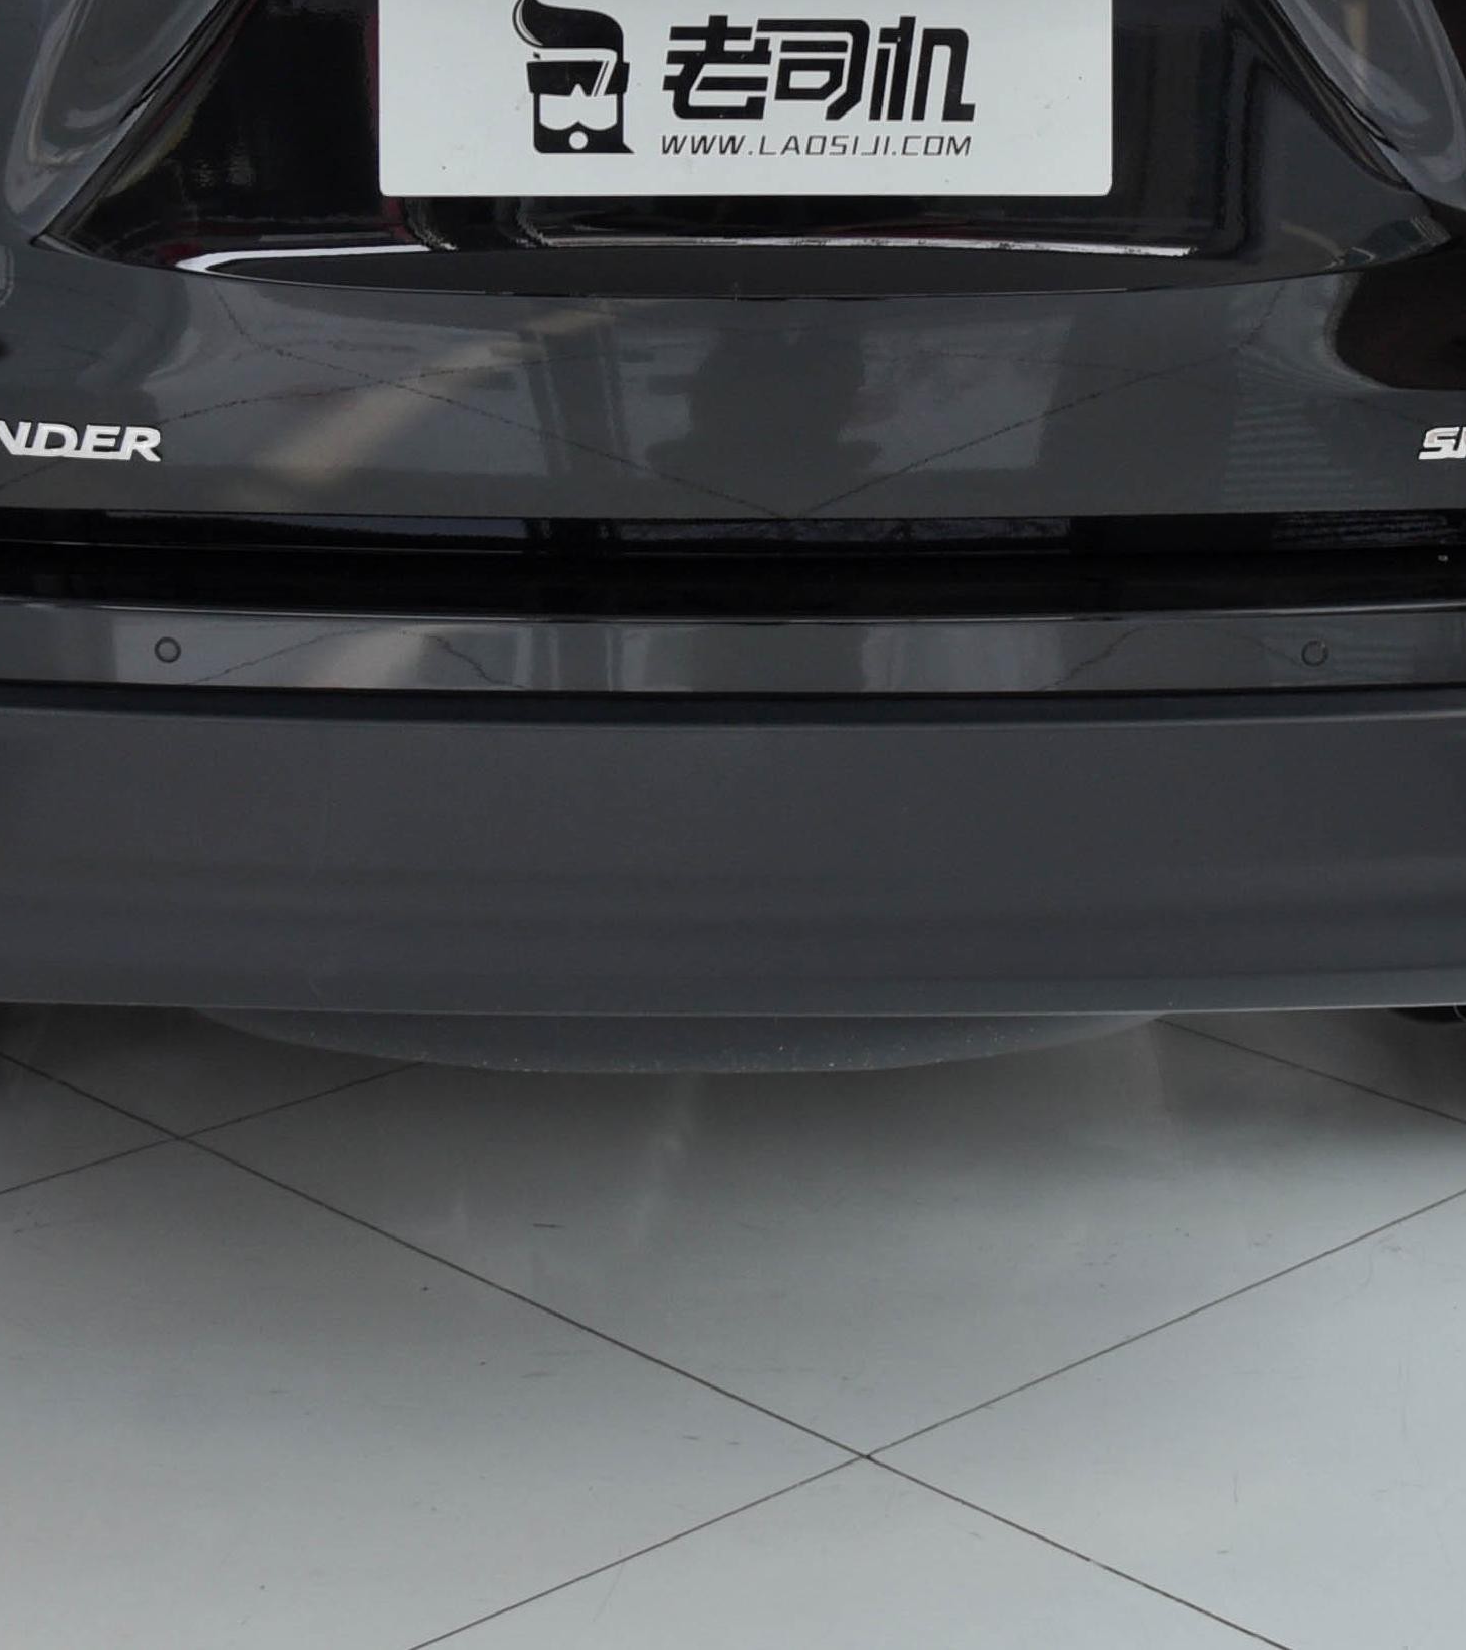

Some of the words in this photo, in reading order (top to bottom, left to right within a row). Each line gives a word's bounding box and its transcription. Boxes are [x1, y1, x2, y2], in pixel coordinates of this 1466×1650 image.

[662, 14, 976, 122] 老司机
[661, 134, 973, 158] WWW.LAOSIJI.COM
